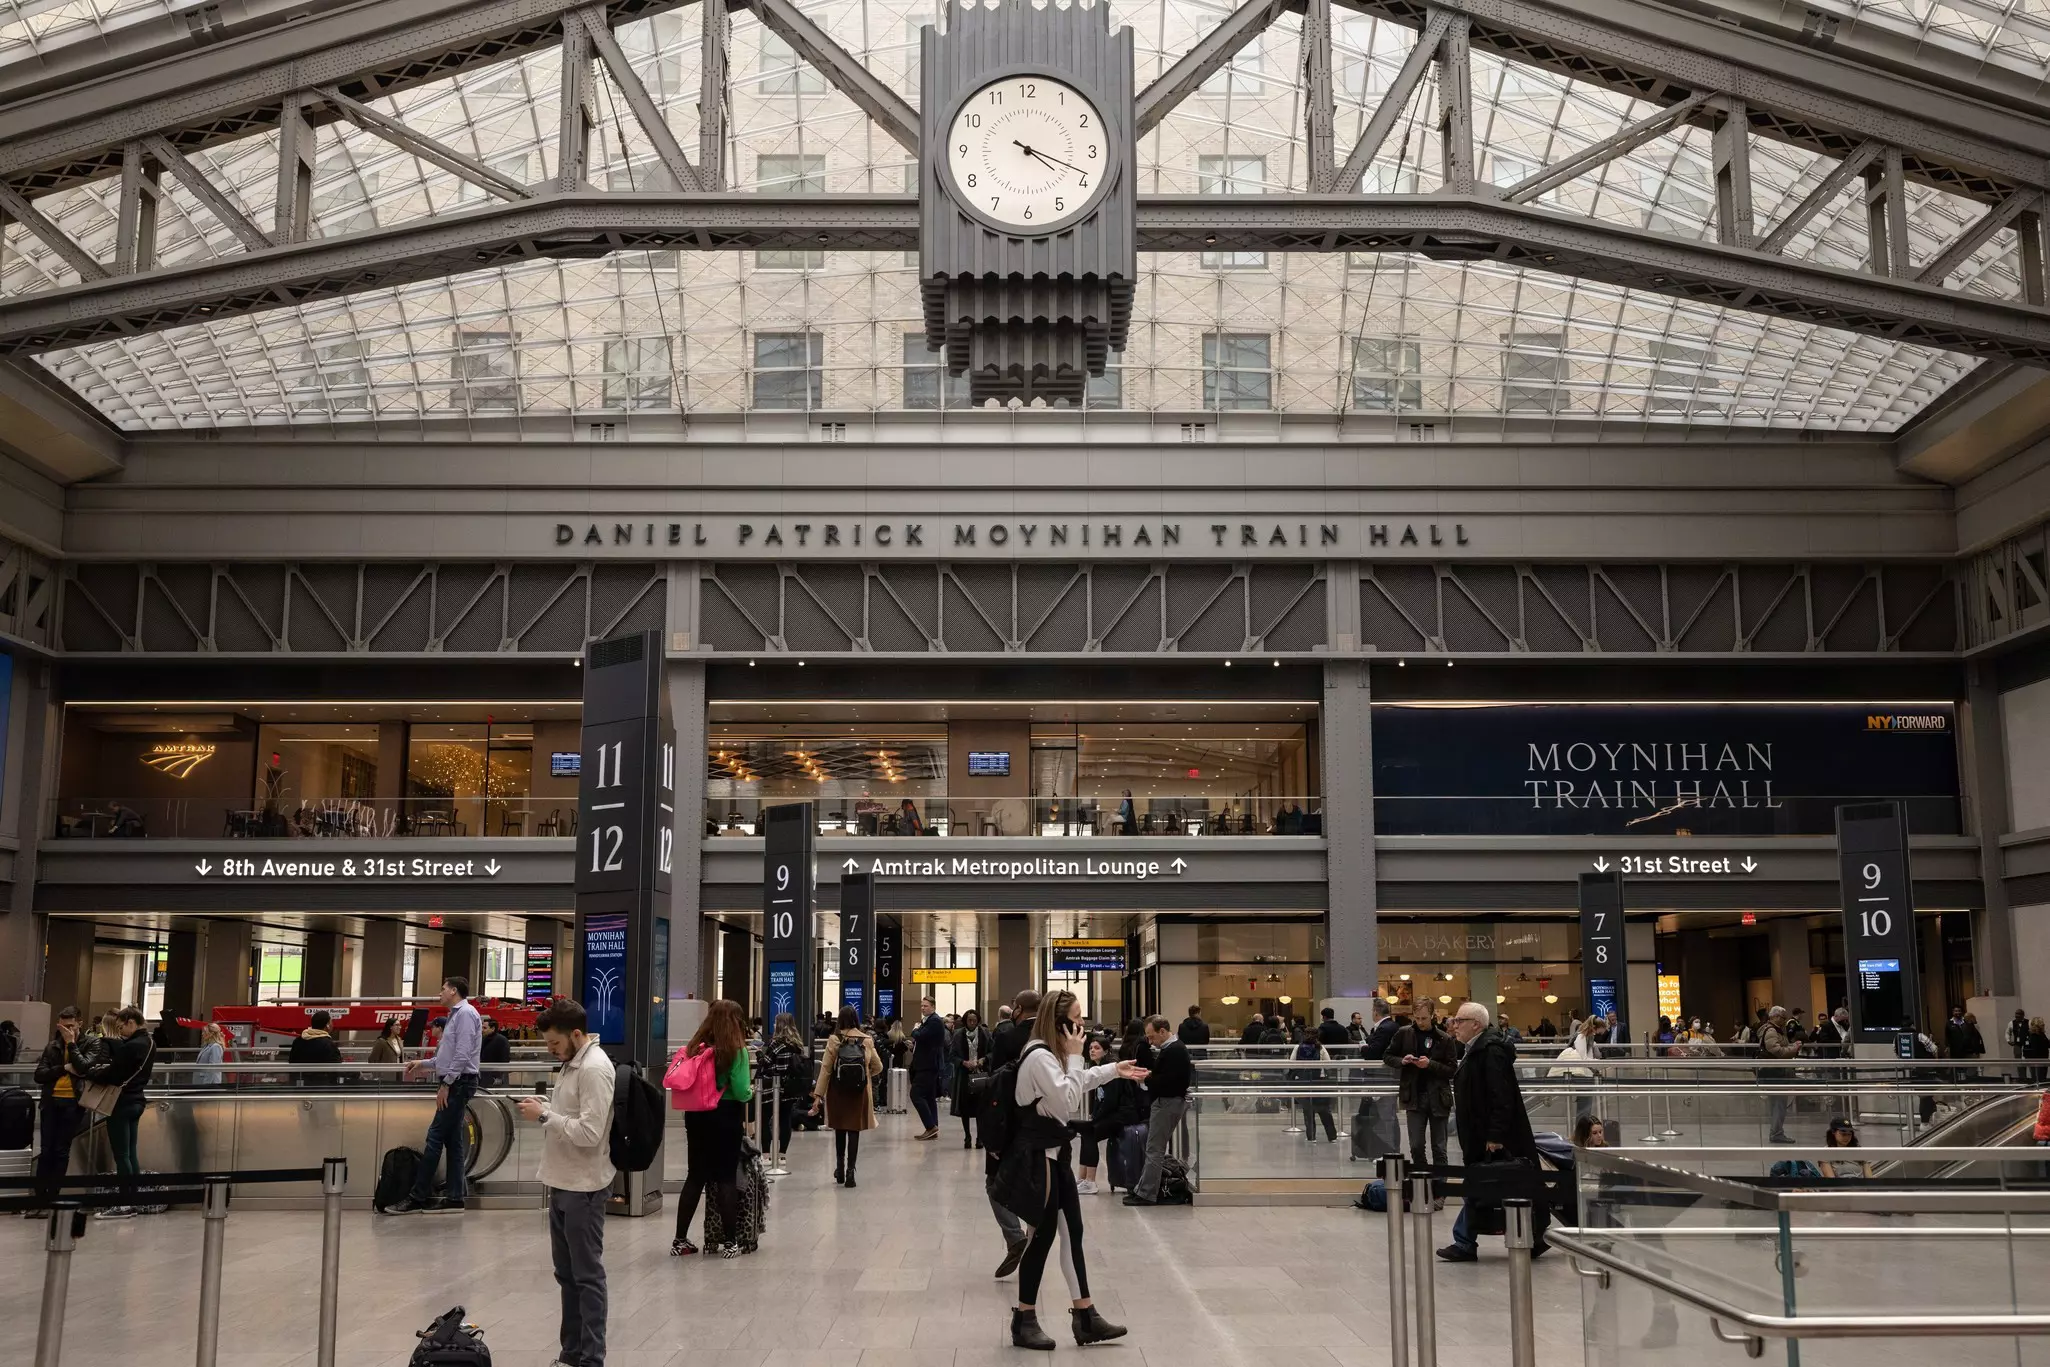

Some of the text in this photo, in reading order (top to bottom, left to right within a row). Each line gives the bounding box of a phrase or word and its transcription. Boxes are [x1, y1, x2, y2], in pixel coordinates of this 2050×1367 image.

[989, 91, 1002, 105] 11
[1019, 84, 1036, 98] 12
[1058, 92, 1064, 105] 1
[964, 114, 981, 128] 10
[1079, 114, 1088, 128] 2
[959, 144, 968, 158] 9
[1088, 145, 1097, 158] 3
[967, 174, 977, 188] 8
[1079, 174, 1088, 188] 4
[991, 197, 1000, 211] 7
[1055, 197, 1064, 211] 5
[1024, 205, 1032, 219] 6
[555, 523, 1469, 545] DANIEL PATRICK MOYNIHAN TRAIN HALL
[1867, 716, 1945, 729] NY FORWARD
[153, 744, 216, 752] AMTRAK
[1527, 742, 1773, 771] MOYNIHAN
[595, 741, 623, 789] 11
[662, 742, 673, 791] 11
[1524, 780, 1783, 809] TRAIN HALL
[590, 825, 624, 873] 12
[659, 826, 673, 874] 12
[222, 858, 474, 876] 8th Avenue & 31st Street
[871, 858, 1160, 879] Amtrak Metropolitan Lounge
[1620, 856, 1731, 873] 31st Street
[776, 865, 789, 891] 9
[1862, 864, 1881, 889] 9
[772, 912, 793, 939] 10
[850, 915, 858, 933] 7
[1594, 913, 1606, 931] 7
[1860, 910, 1891, 937] 10
[588, 931, 624, 941] MOYNIHAN
[1424, 935, 1497, 949] BAKERY
[587, 941, 625, 951] TRAIN HALL
[882, 937, 890, 952] 5
[849, 947, 858, 966] 8
[1596, 945, 1608, 964] 8
[882, 962, 890, 977] 6
